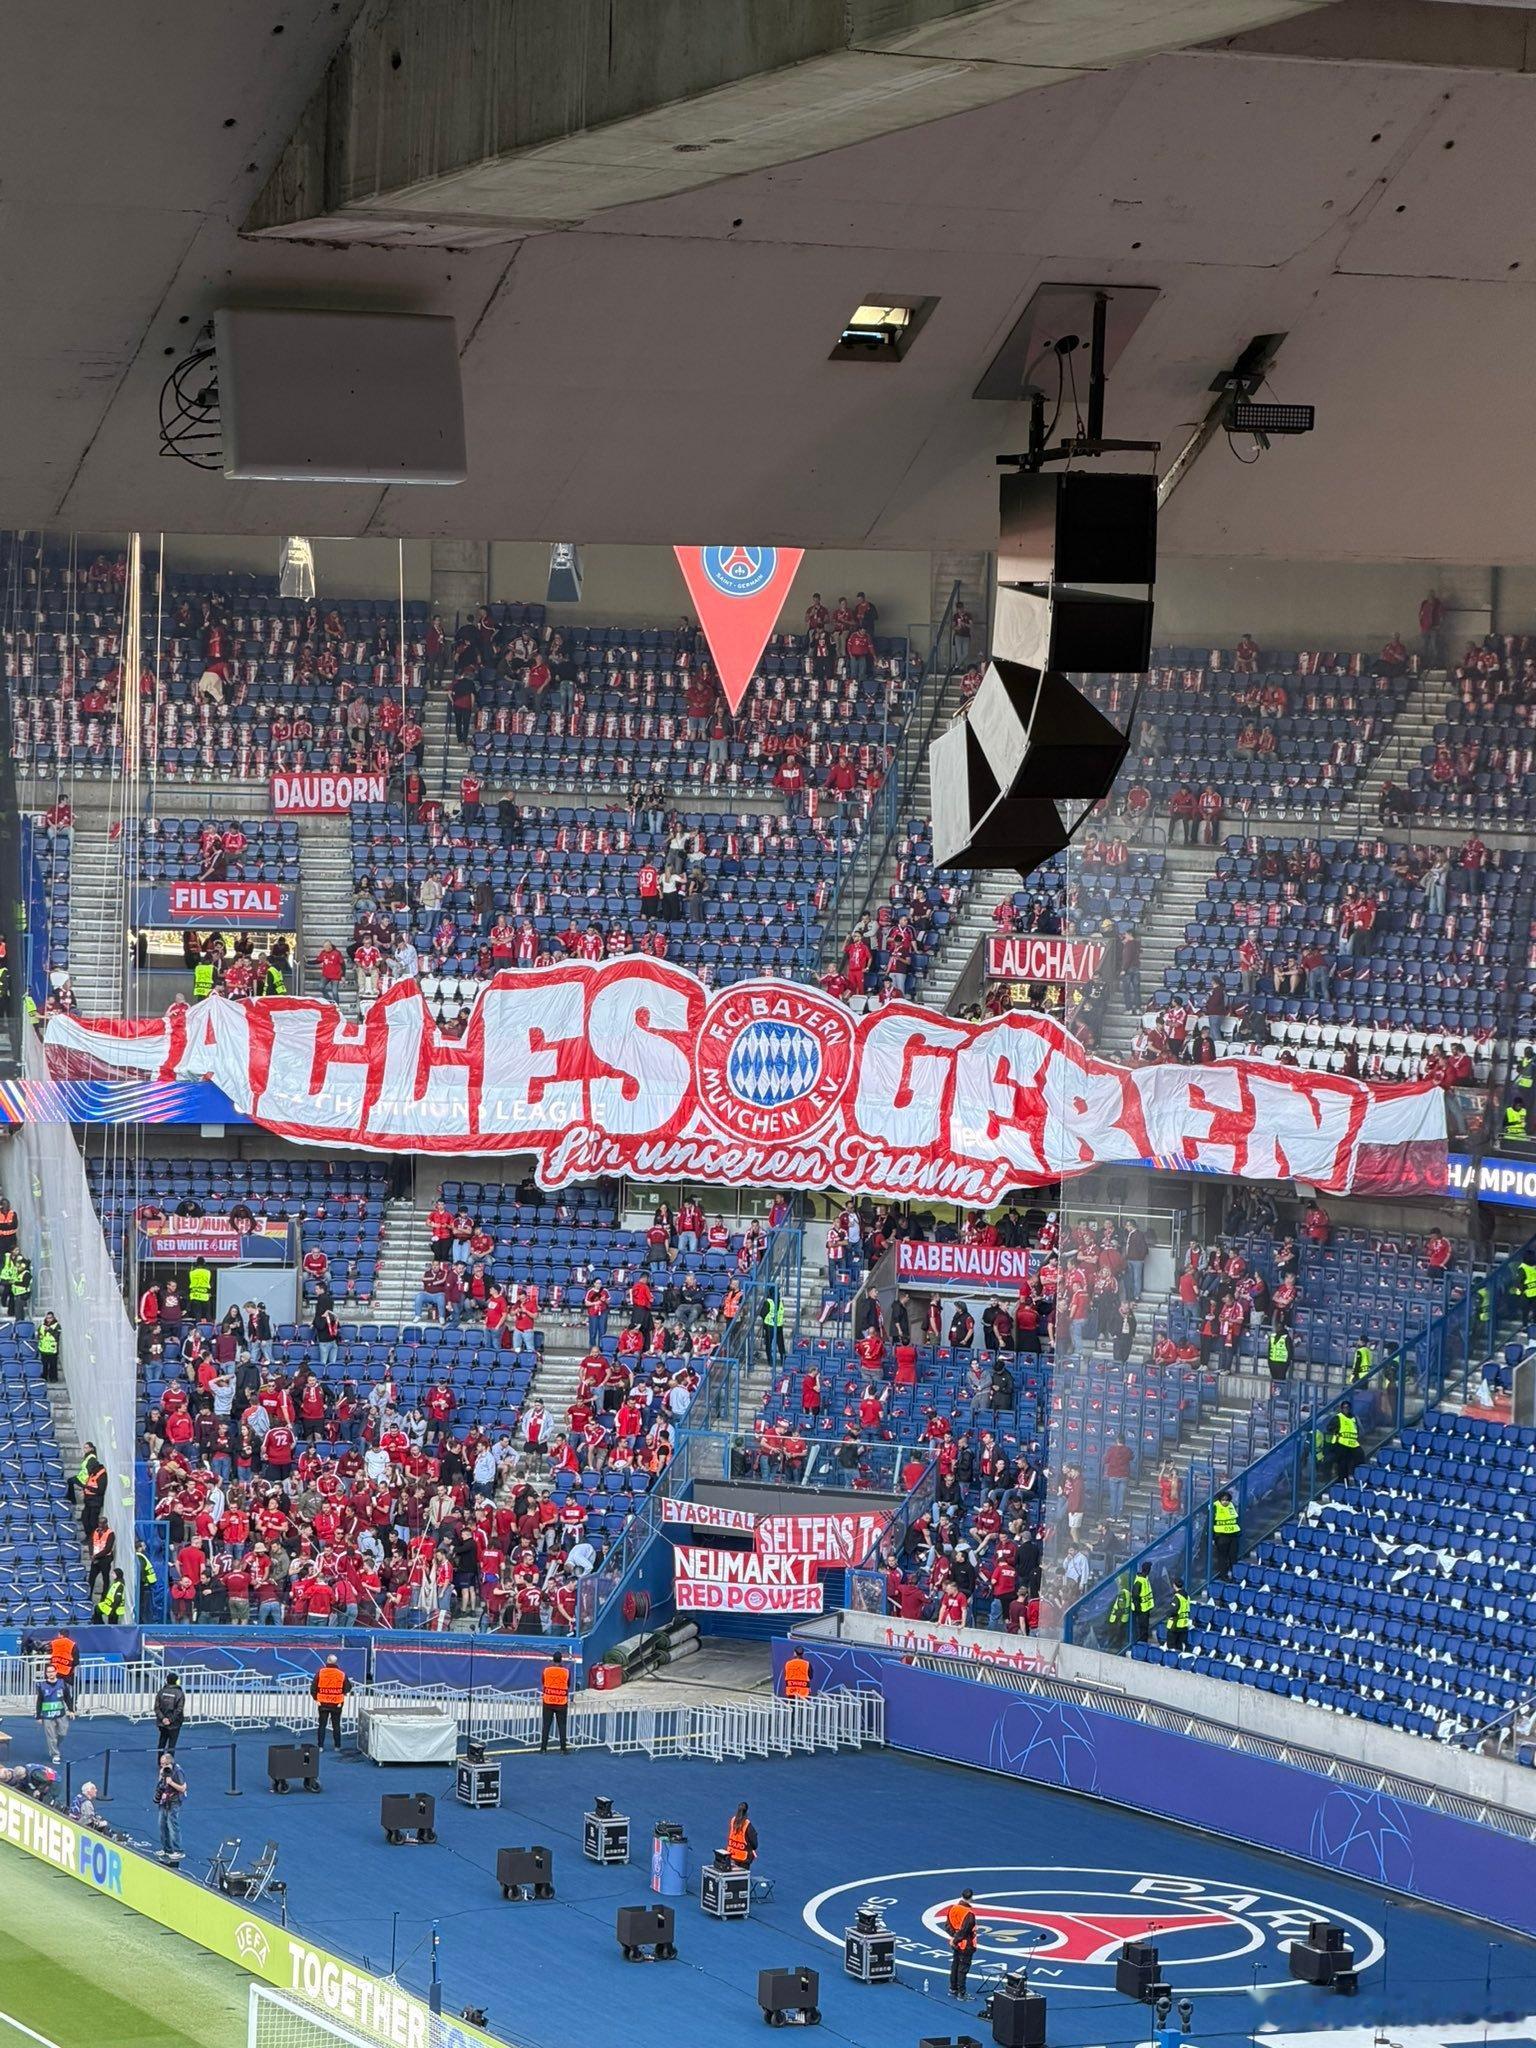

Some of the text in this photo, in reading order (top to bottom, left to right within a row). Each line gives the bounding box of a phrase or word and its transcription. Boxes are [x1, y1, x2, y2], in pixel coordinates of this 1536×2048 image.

[274, 777, 385, 808] DAUBORN
[175, 888, 277, 911] FILSTAL
[709, 997, 846, 1047] F.C. BAYERN
[175, 976, 692, 1136] ALLES
[808, 1075, 843, 1110] E.V.
[545, 1126, 1008, 1199] für unseren Traum!
[156, 1237, 238, 1252] RED WHITE 4 LIFE
[900, 1243, 1026, 1277] RABENAU/SN
[662, 1498, 756, 1531] EYACHTAL
[760, 1515, 854, 1561] SELTERS
[674, 1546, 819, 1585] NEUMARKT
[677, 1583, 822, 1613] RED POWER
[80, 1835, 122, 1895] FOR
[236, 1926, 267, 1964] UEFA
[288, 1942, 426, 2048] TOGETHER
